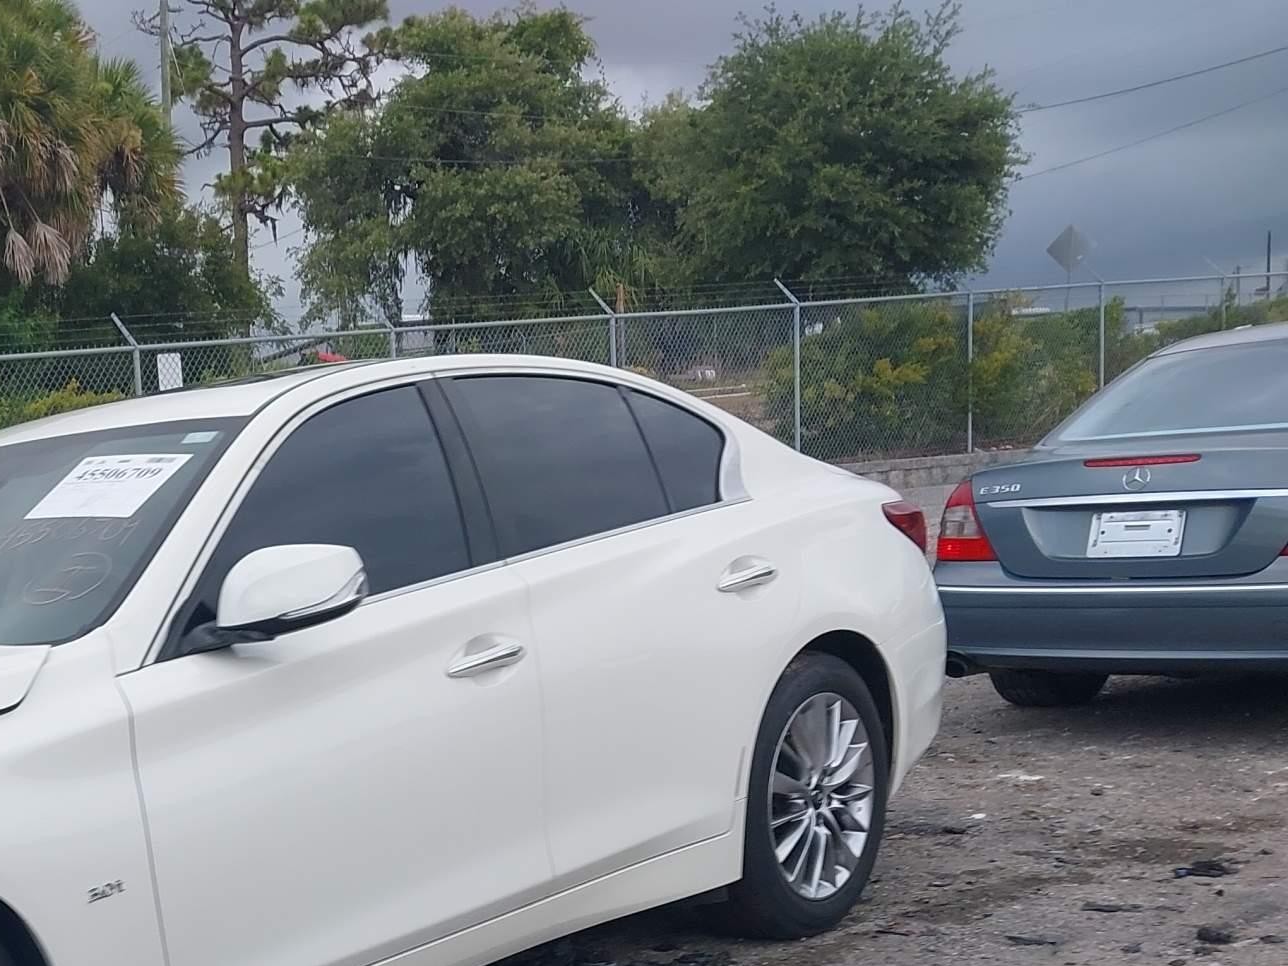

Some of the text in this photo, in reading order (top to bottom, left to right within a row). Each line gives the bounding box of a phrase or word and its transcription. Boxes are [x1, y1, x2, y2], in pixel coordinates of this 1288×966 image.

[76, 467, 163, 481] 45506709
[979, 483, 1021, 495] E 350
